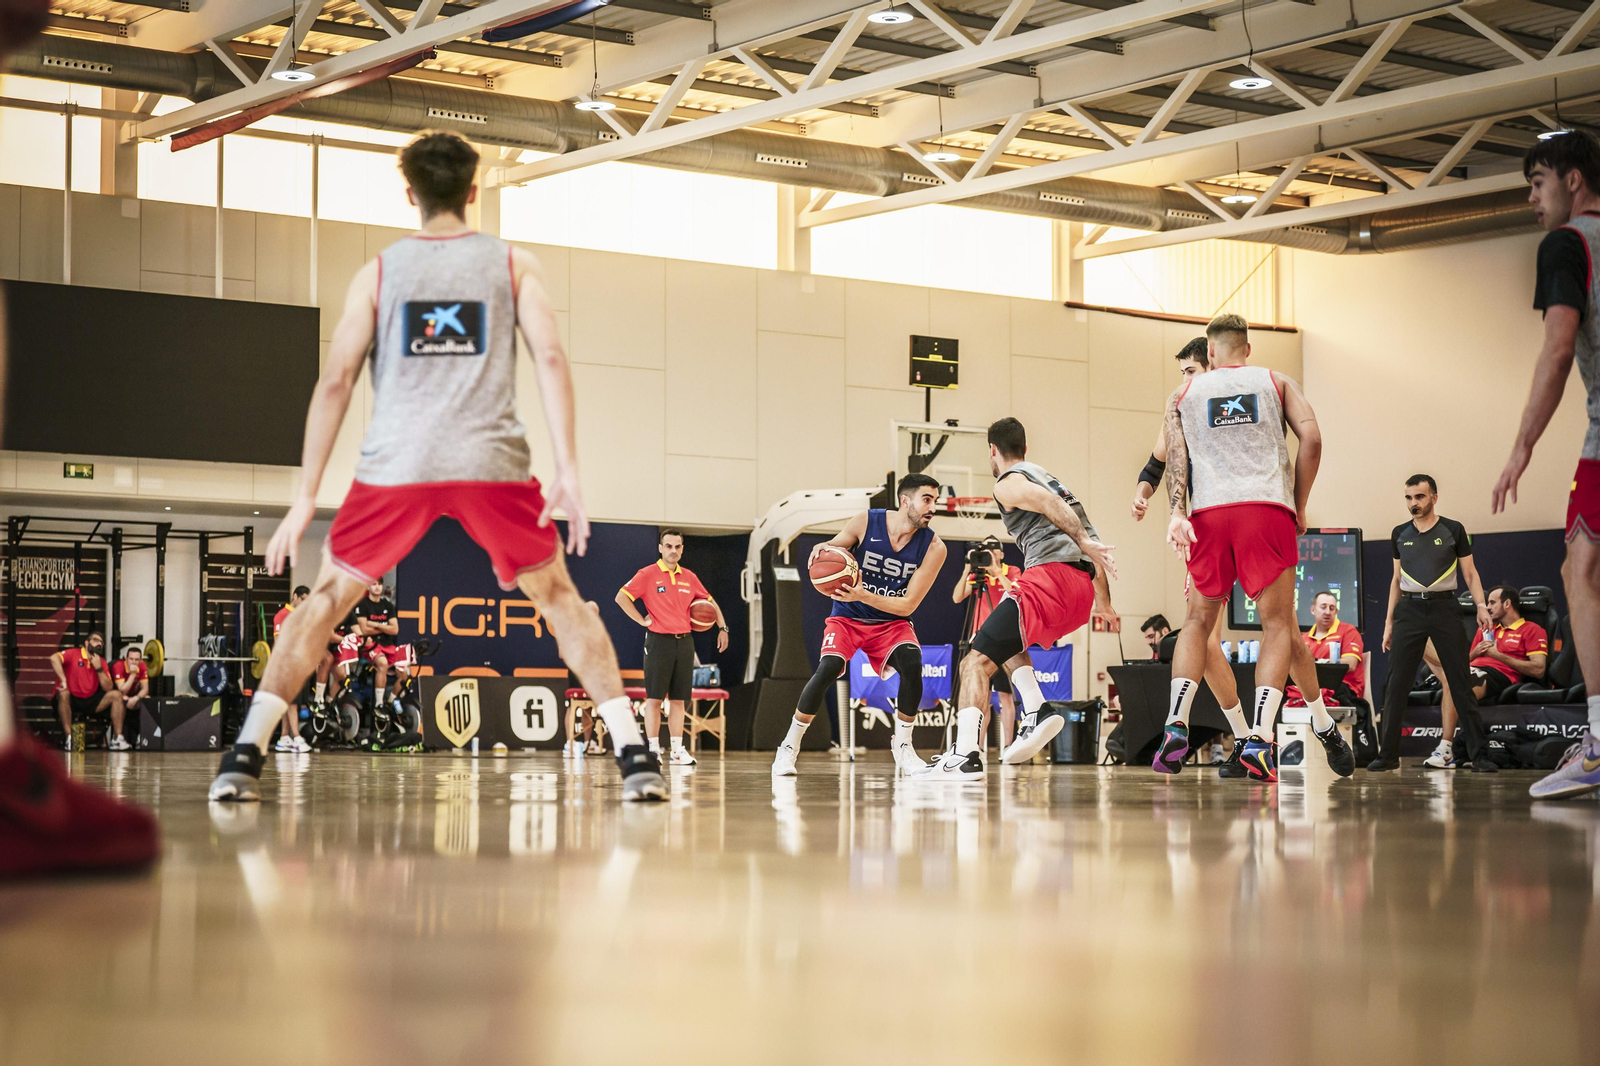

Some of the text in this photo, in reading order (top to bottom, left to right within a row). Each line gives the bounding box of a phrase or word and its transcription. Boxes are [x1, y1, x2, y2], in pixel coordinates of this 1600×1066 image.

[411, 338, 476, 354] CaixaBank
[1214, 415, 1252, 425] CaixaBank
[18, 559, 75, 571] ERIANSPORTECH
[16, 570, 75, 590] ECRETGYM
[921, 664, 947, 678] lten
[1034, 670, 1059, 683] lten
